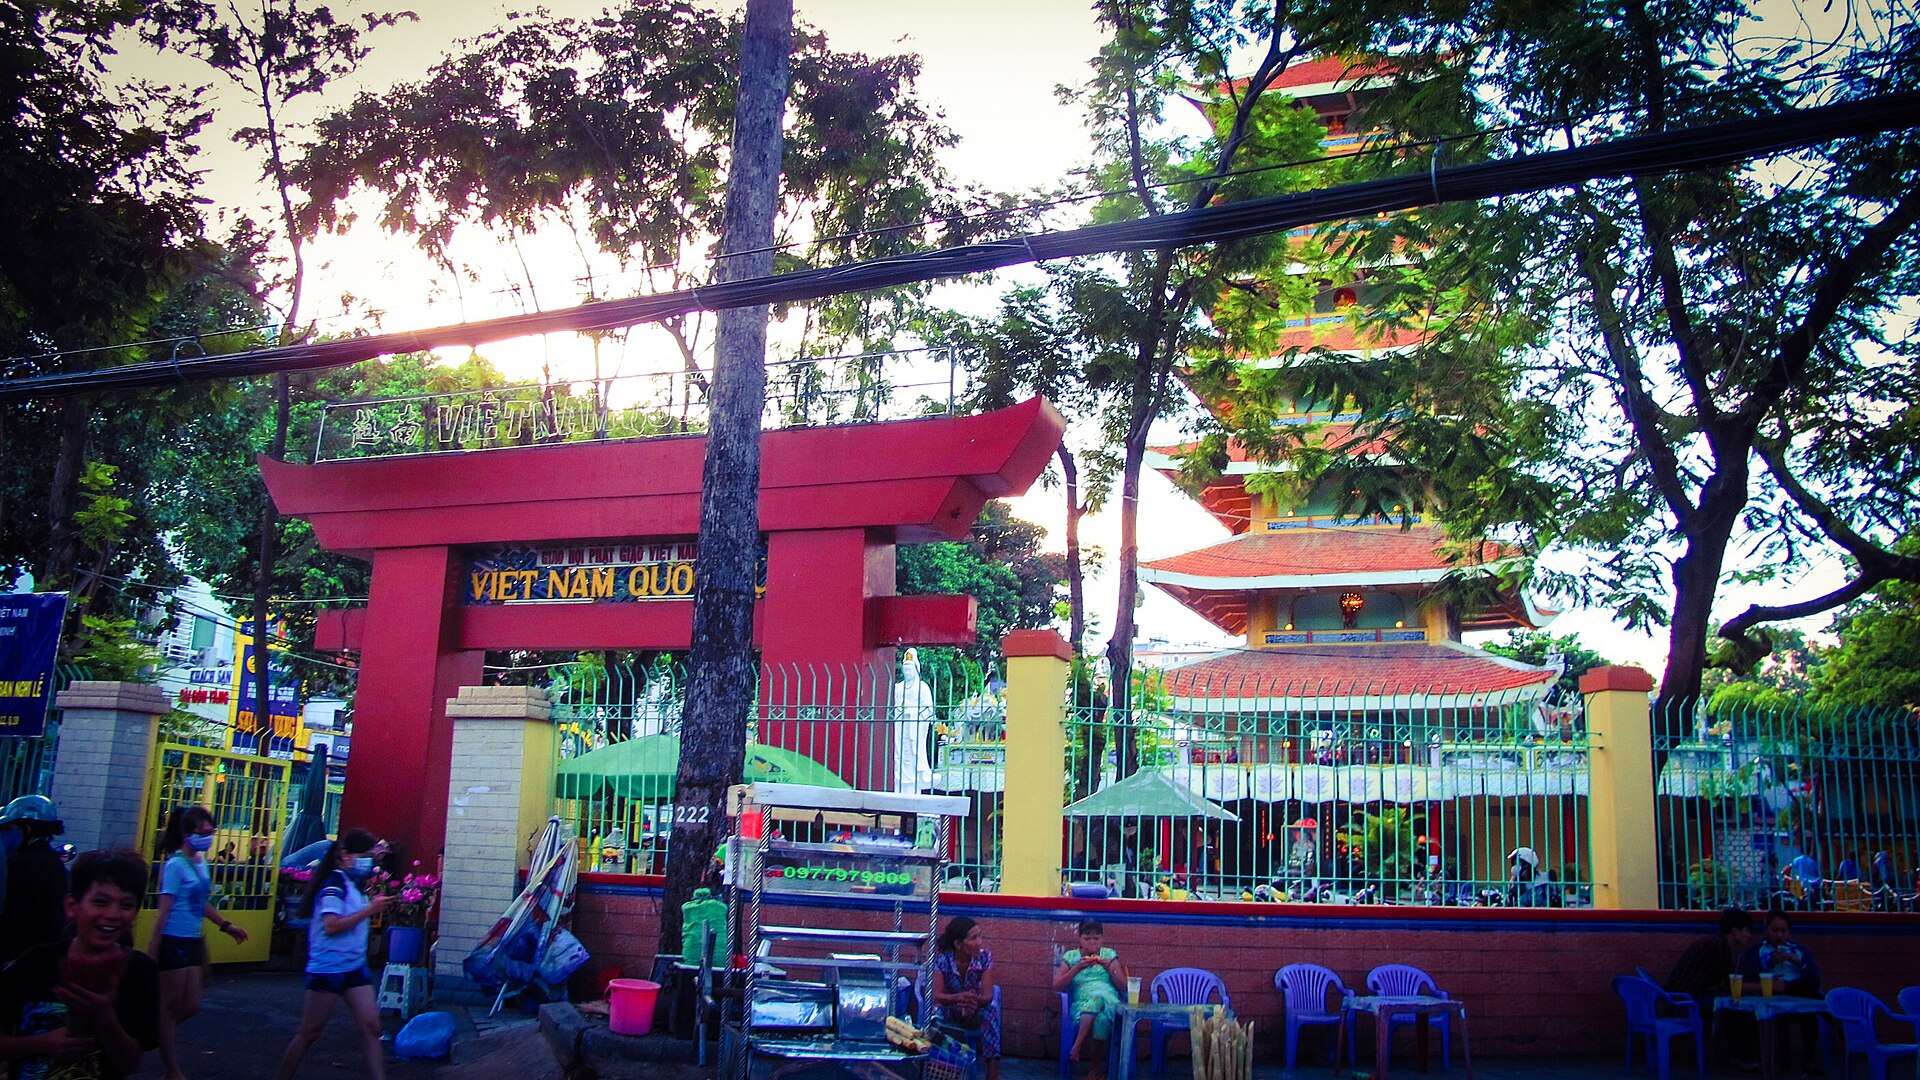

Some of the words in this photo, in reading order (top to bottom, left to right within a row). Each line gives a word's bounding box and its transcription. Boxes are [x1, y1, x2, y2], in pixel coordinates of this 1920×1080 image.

[547, 567, 616, 599] NAM
[676, 806, 709, 823] 222
[784, 866, 912, 885] 0977979809
